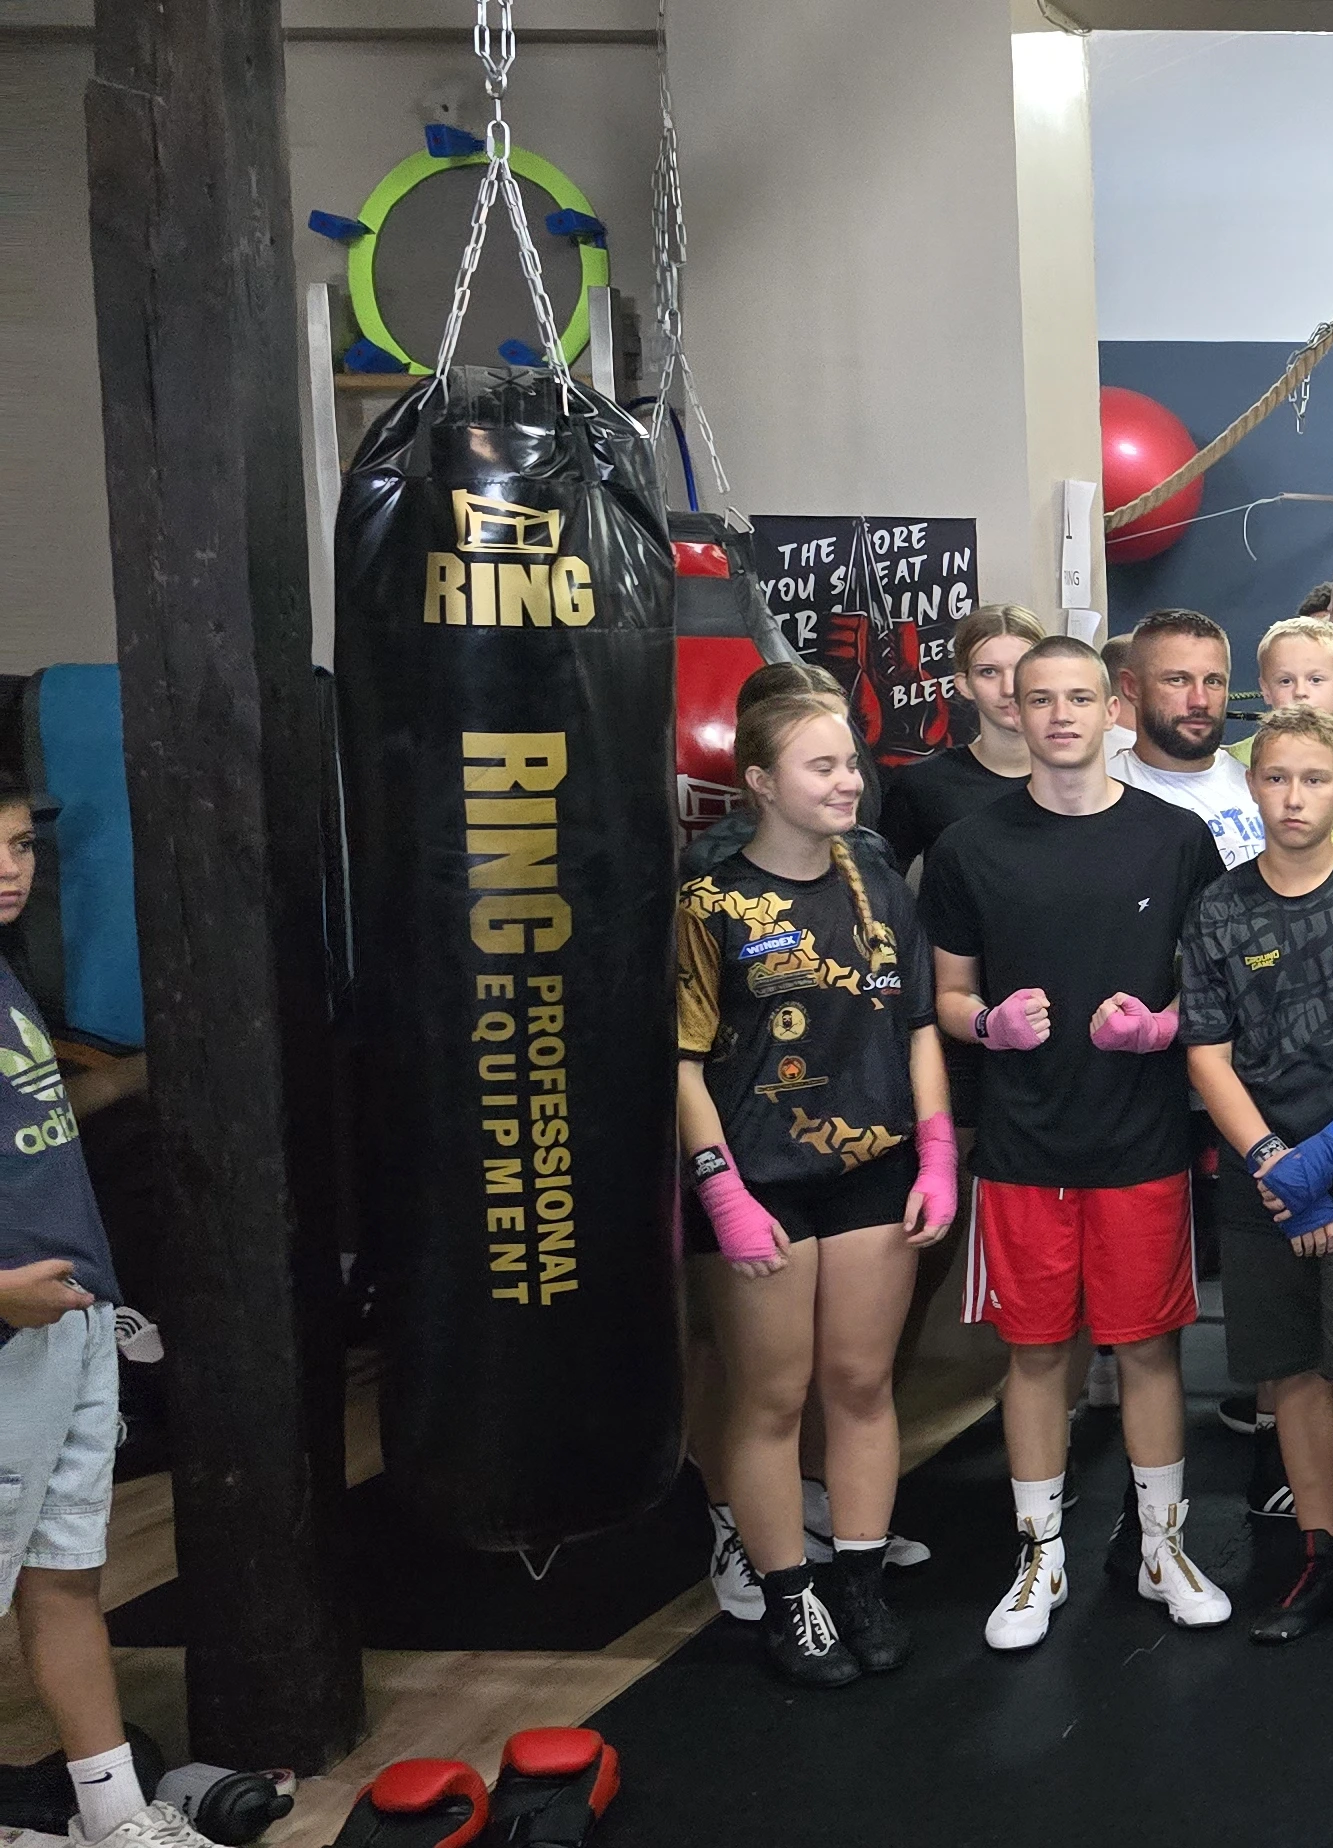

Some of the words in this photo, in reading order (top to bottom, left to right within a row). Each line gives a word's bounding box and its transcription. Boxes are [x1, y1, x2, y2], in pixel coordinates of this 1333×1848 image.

[759, 573, 815, 605] YOU
[830, 554, 928, 595] SEAT
[943, 547, 970, 577] IN
[778, 537, 837, 570] THE
[868, 523, 928, 554] ORE
[424, 552, 595, 627] RING
[462, 731, 573, 954] RING
[746, 934, 796, 955] WINDEX
[471, 974, 530, 1306] EQUIPMENT
[527, 975, 579, 1306] PROFESSIONAL
